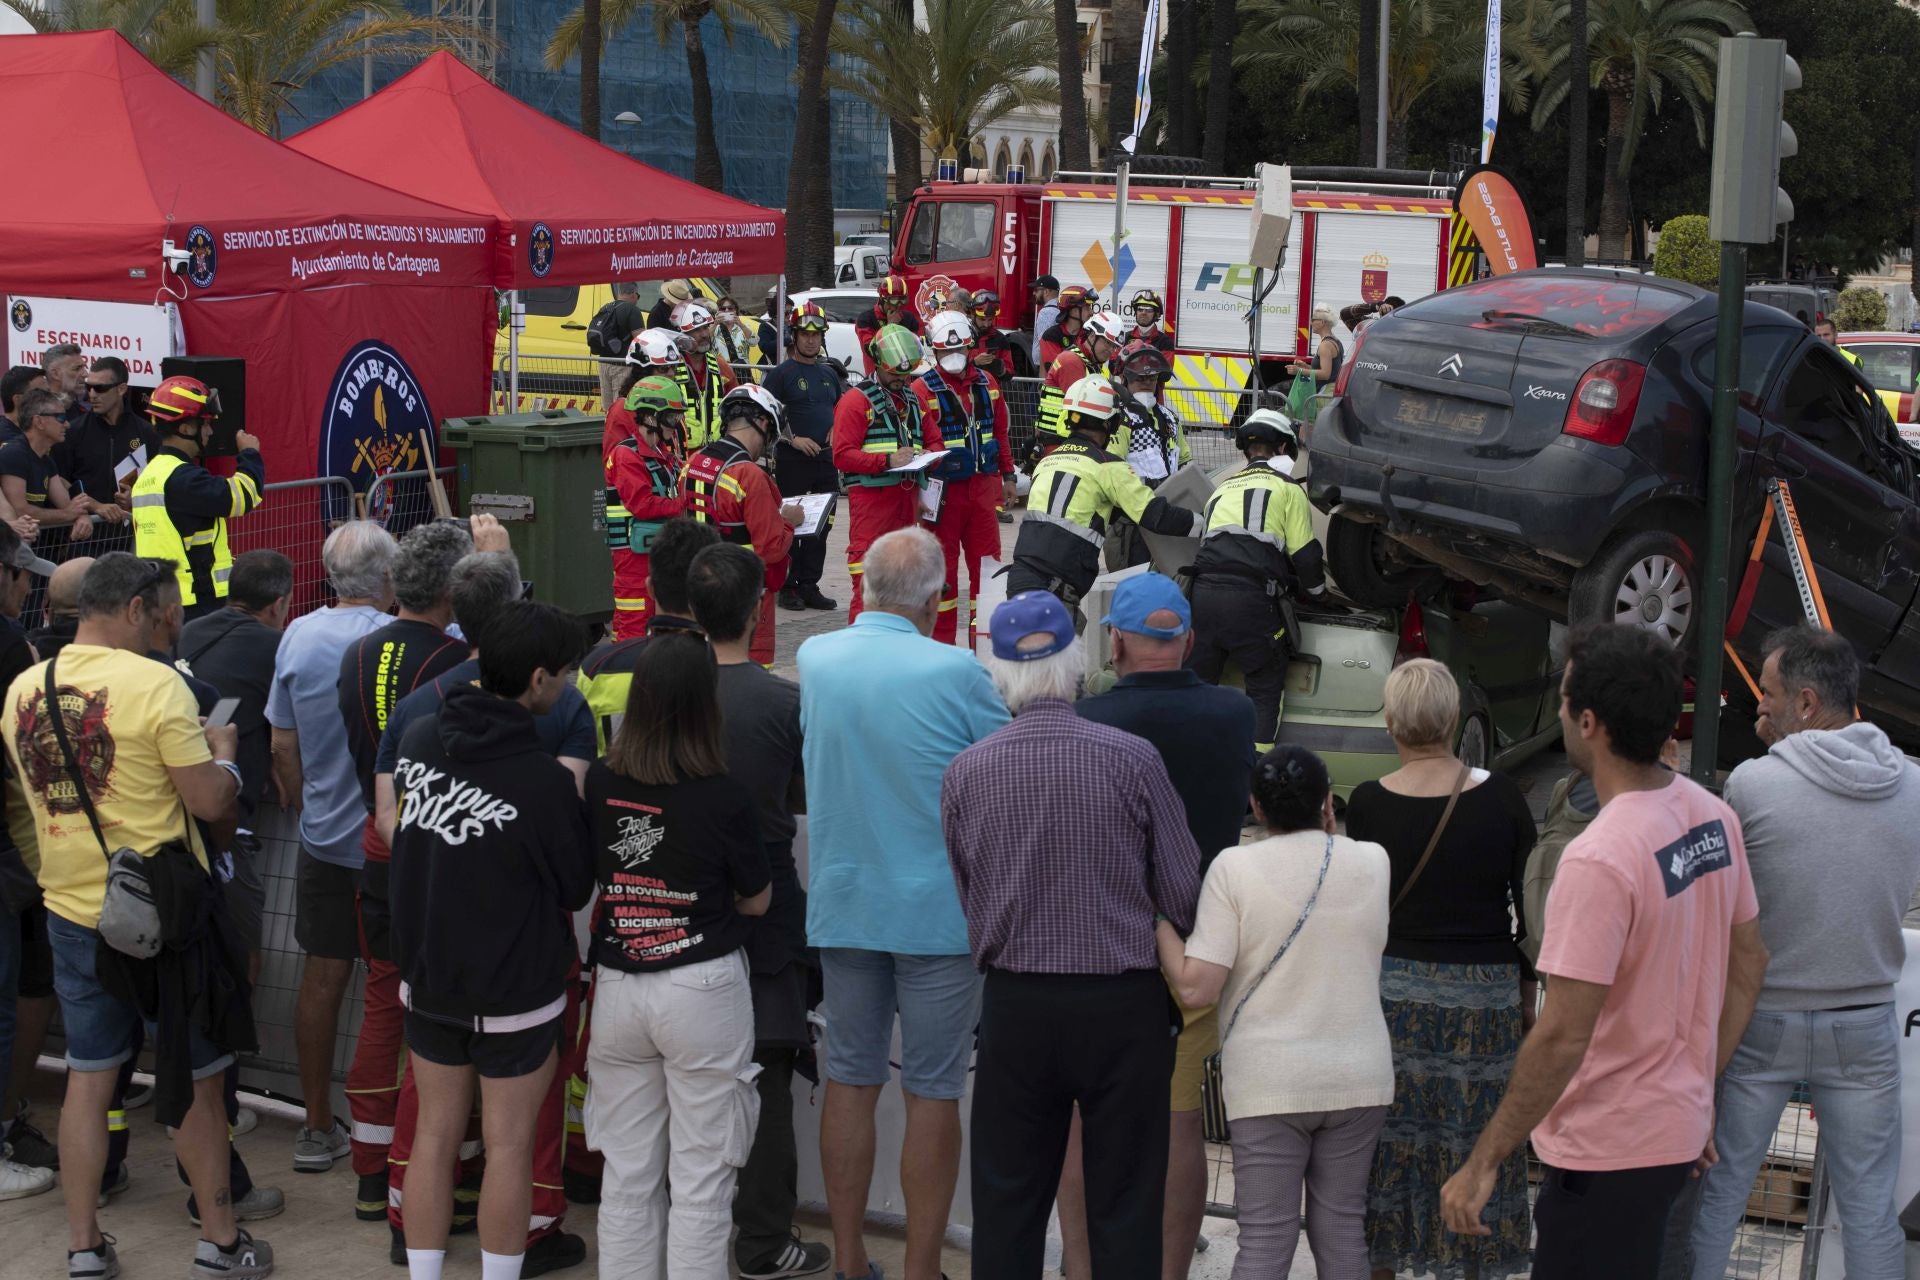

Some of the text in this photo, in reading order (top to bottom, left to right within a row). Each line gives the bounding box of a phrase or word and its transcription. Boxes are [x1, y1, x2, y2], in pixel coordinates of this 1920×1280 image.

[223, 219, 486, 250] SERVICIO DE EXTINCIÓN DE INCENDIOS Y SALVAMENTO
[560, 228, 601, 245] SERVICIO
[603, 228, 615, 243] DE
[616, 222, 659, 242] EXTINCIÓN
[661, 225, 673, 240] DE
[674, 224, 718, 240] INCENDIOS
[718, 223, 725, 239] Y
[725, 222, 776, 239] SALVAMENTO
[291, 250, 441, 280] Ayuntamiento de Cartagena
[610, 248, 734, 275] Ayuntamiento de Cartagena
[1186, 299, 1291, 315] Formación Prosional
[37, 329, 142, 351] ESCENARIO 1
[1356, 360, 1389, 372] CITROËN
[339, 358, 417, 419] BOMBEROS
[1523, 384, 1567, 401] Xsara
[376, 641, 395, 731] BOMBEROS
[612, 872, 667, 889] MURCIA
[607, 884, 699, 901] 10 NOVIEMBRE
[614, 906, 672, 918] MADRID
[618, 917, 690, 928] DICIEMBRE
[639, 933, 704, 957] DICIEMBRE
